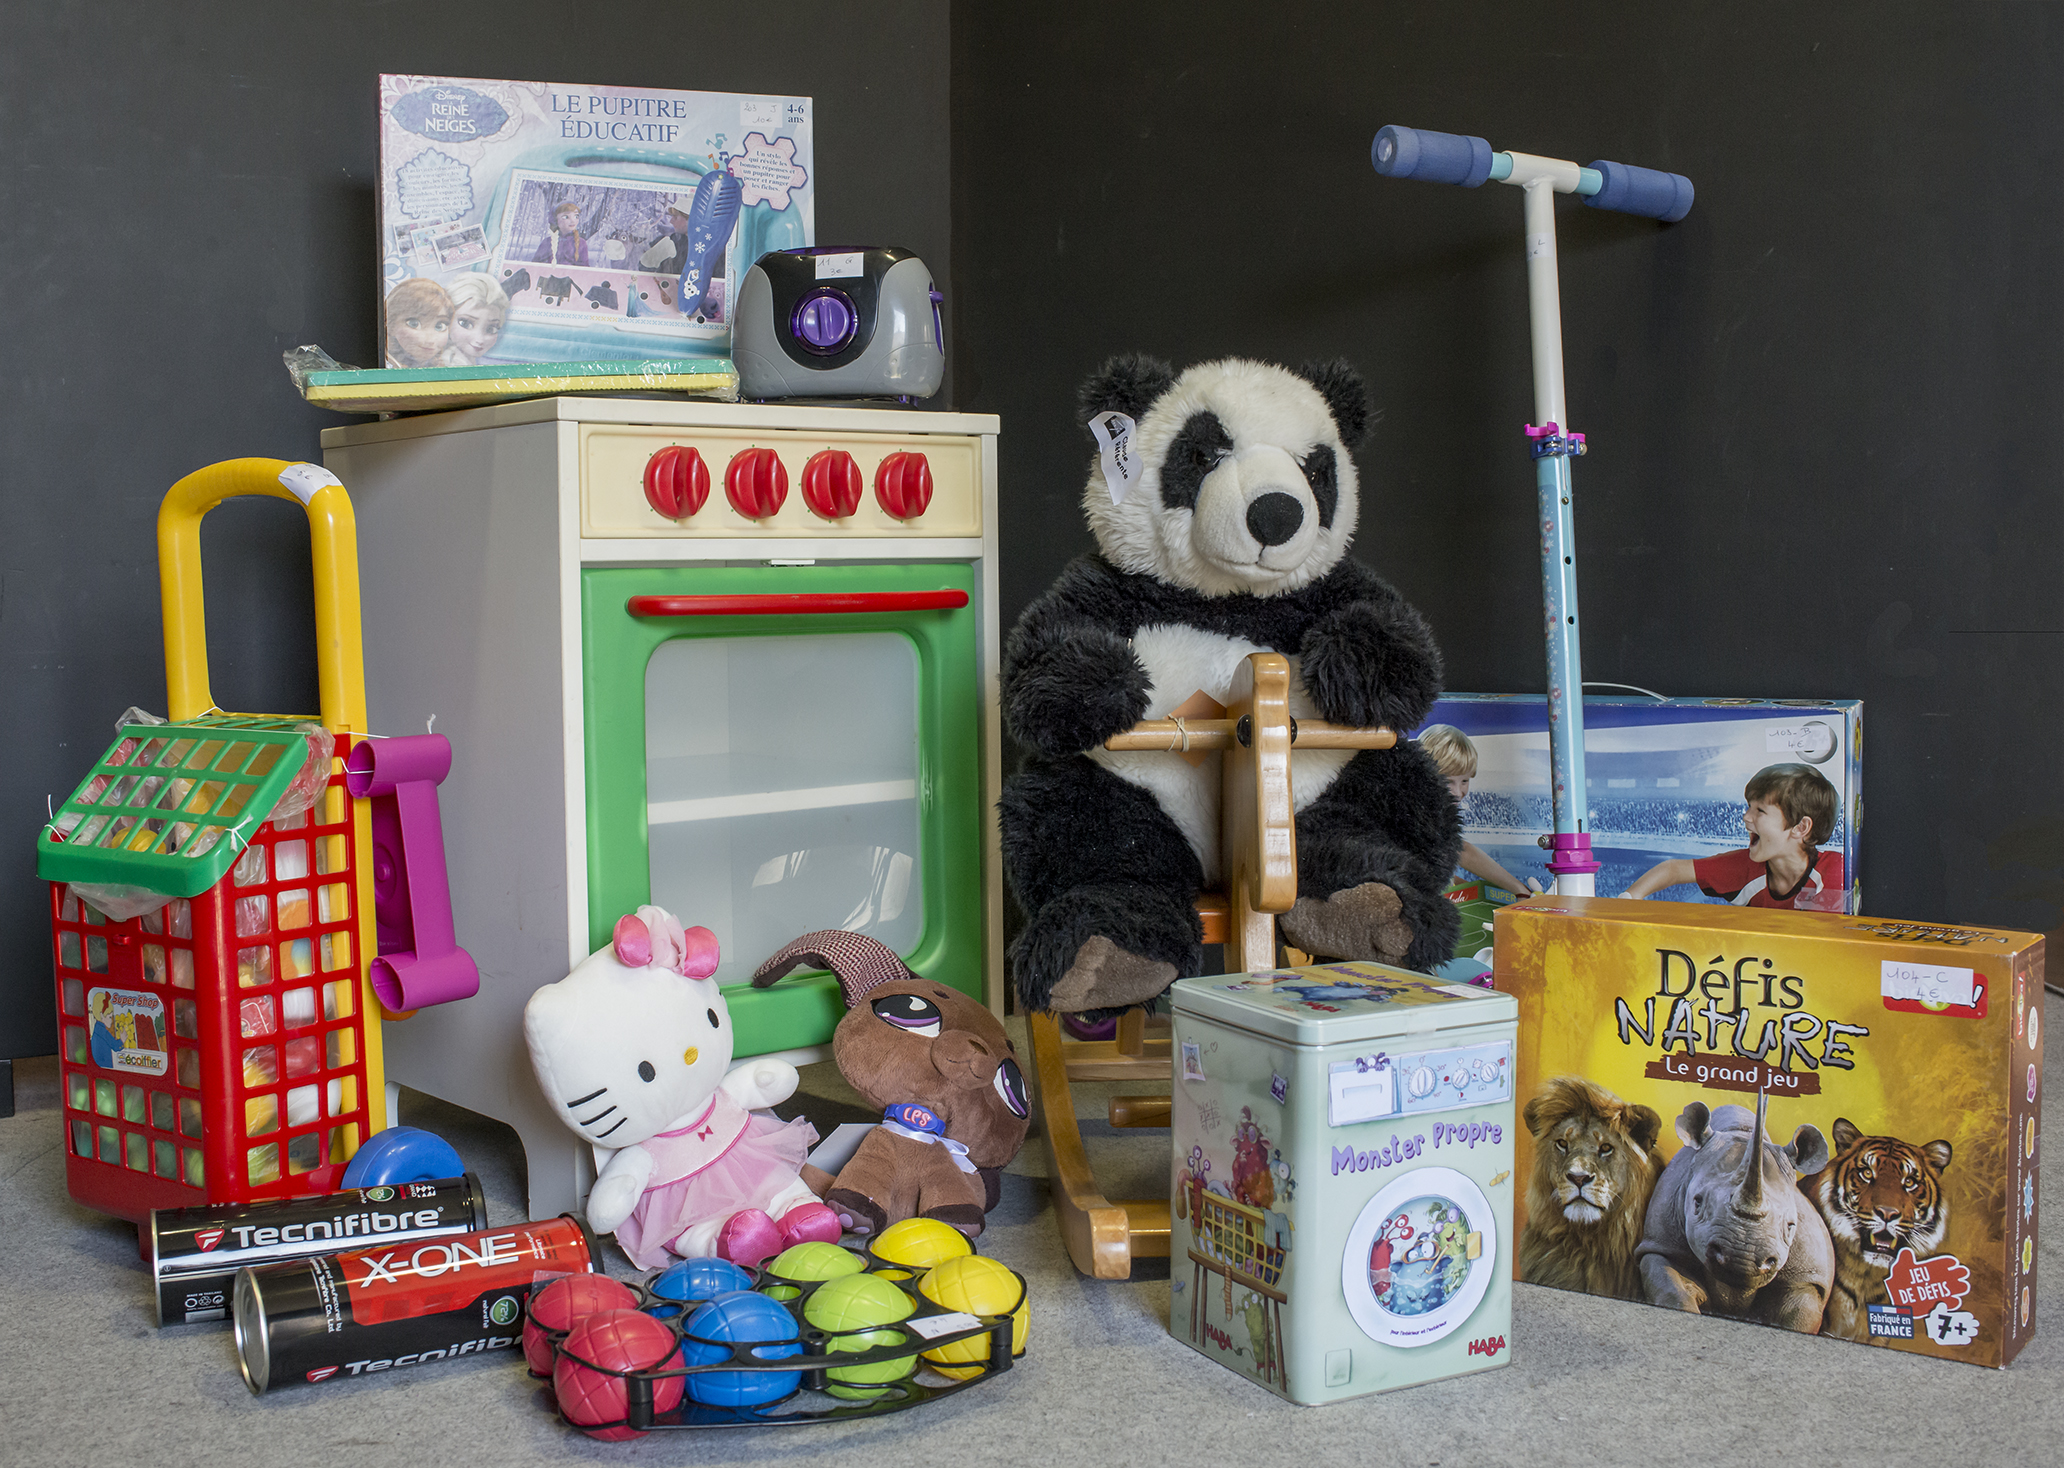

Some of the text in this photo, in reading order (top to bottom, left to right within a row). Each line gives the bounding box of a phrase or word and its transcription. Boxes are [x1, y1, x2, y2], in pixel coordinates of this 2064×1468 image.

[431, 103, 470, 116] REINE
[551, 94, 687, 119] LE PUPITRE
[787, 103, 805, 115] 4-6
[425, 117, 477, 134] NEIGES
[560, 115, 680, 142] ÉDUCATIF
[787, 116, 805, 124] ans
[766, 152, 782, 160] stylo
[752, 171, 775, 179] pupitre
[1489, 889, 1517, 903] SUPER
[1655, 948, 1804, 1016] Défis
[1916, 986, 1940, 998] 4€
[112, 993, 159, 1010] Super Shop
[1615, 996, 1870, 1074] NATURE
[125, 1055, 162, 1068] écoiffier
[1665, 1056, 1799, 1089] Le grand jeu
[903, 1106, 933, 1127] LPS
[1331, 1121, 1503, 1176] Monster Propre
[231, 1208, 440, 1248] Tecnifibre
[359, 1232, 520, 1289] X-ONE
[1908, 1266, 1931, 1285] JEU
[1898, 1281, 1952, 1305] DE DÉFIS
[500, 1300, 509, 1322] 72%
[1869, 1312, 1912, 1326] Fabriqué en
[335, 1321, 343, 1332] by
[1205, 1323, 1233, 1351] HABA
[1870, 1323, 1913, 1338] FRANCE
[1937, 1313, 1968, 1340] 7+
[345, 1334, 523, 1376] Tecnifibr
[1468, 1335, 1506, 1357] HABA
